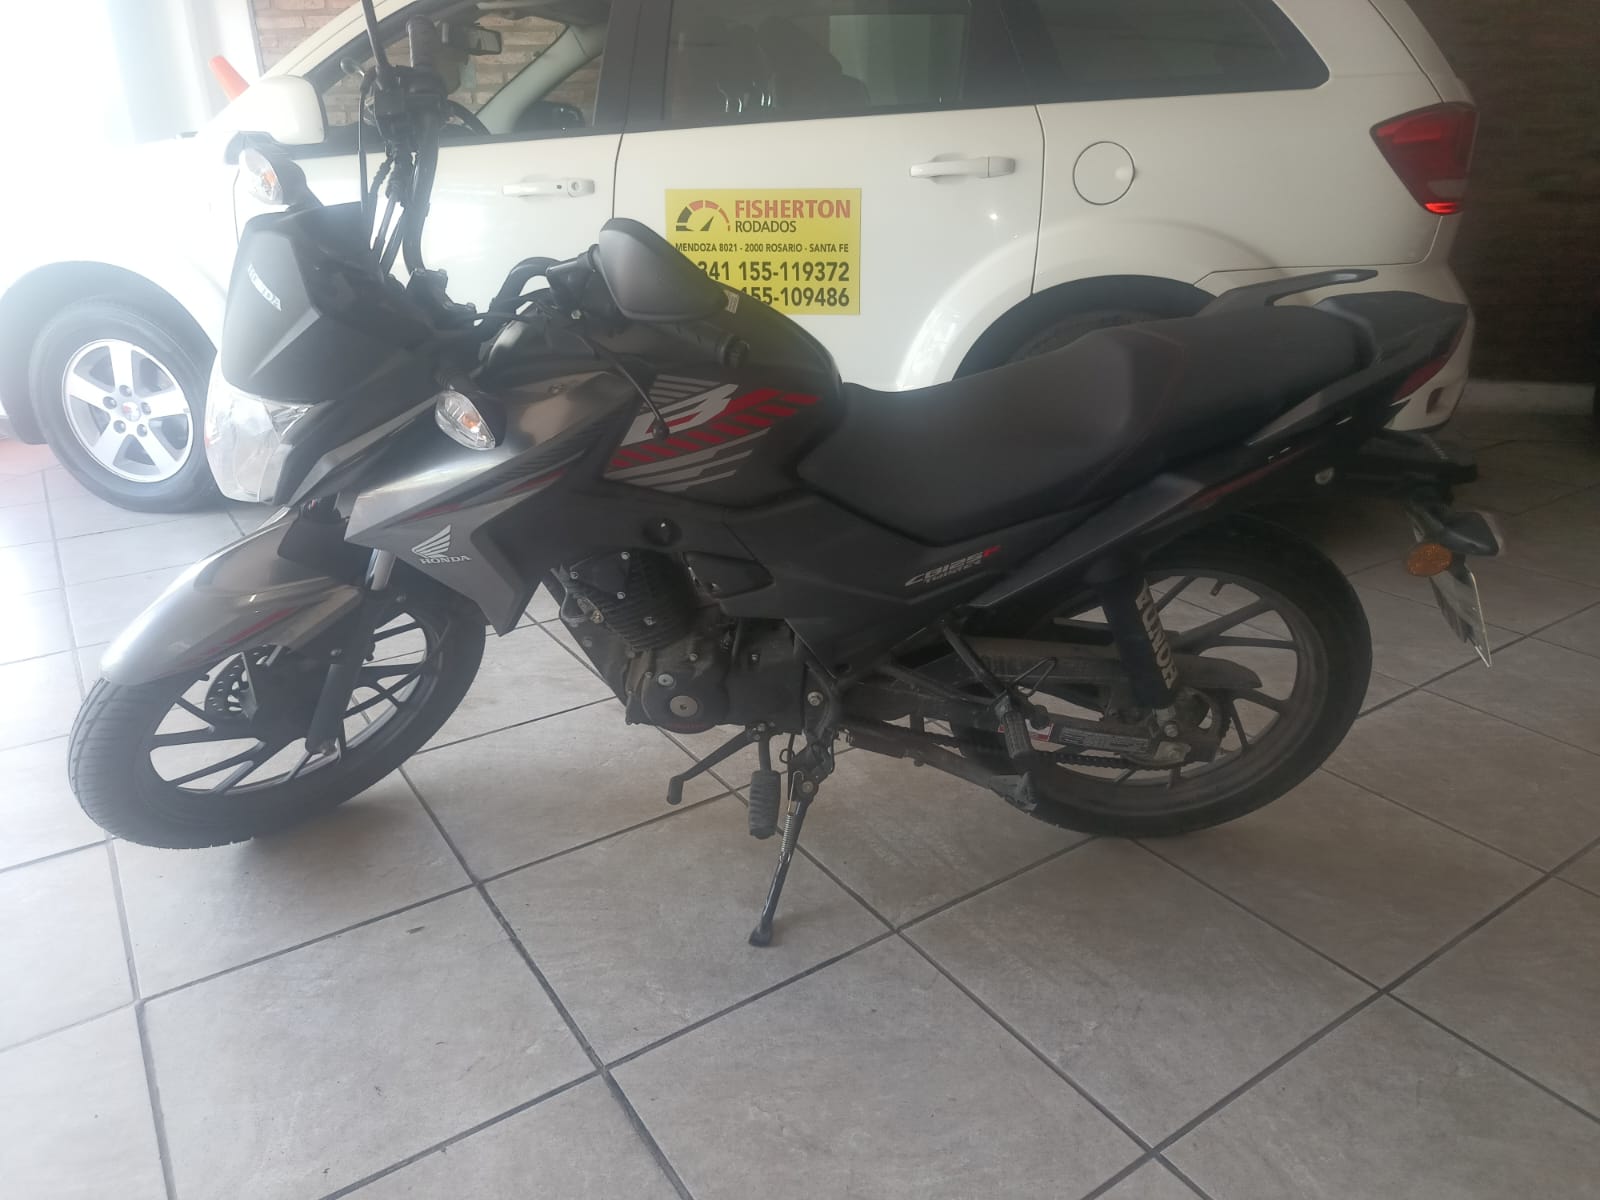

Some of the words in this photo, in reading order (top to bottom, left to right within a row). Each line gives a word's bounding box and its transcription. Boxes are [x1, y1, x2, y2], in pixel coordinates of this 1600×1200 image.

[735, 199, 850, 218] FISHERTON
[735, 220, 796, 232] RODADOS
[675, 243, 717, 252] MENDOZA
[719, 243, 737, 252] 8021
[744, 243, 763, 252] 2000
[765, 243, 803, 253] ROSARIO
[809, 243, 836, 252] SANTA
[838, 243, 849, 252] FE
[738, 261, 850, 282] 155-119372
[420, 555, 472, 564] HONDA
